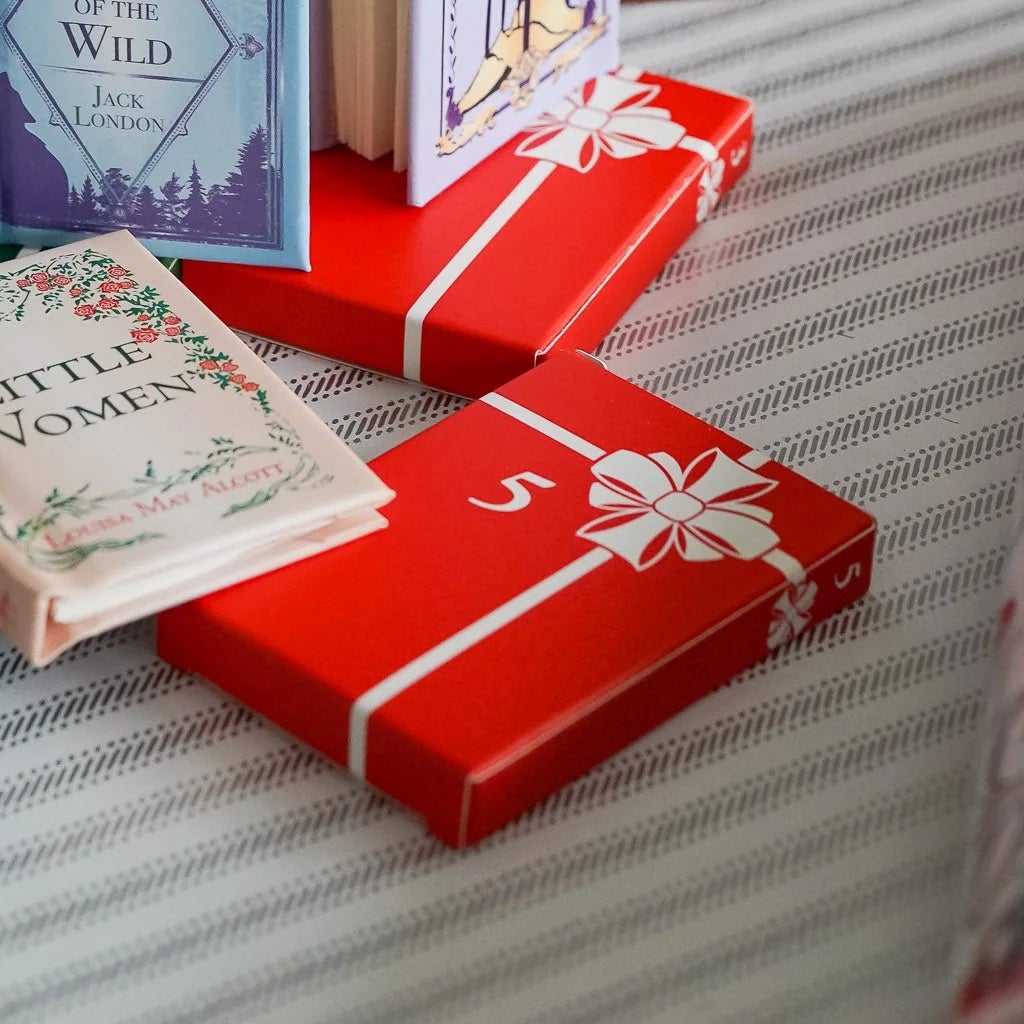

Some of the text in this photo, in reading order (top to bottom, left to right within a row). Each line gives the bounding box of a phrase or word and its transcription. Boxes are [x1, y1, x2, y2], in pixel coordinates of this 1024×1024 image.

[111, 0, 160, 22] THE
[57, 19, 174, 67] WILD
[91, 84, 145, 110] JACK
[73, 105, 166, 134] LONDON
[467, 470, 557, 513] 5
[833, 561, 861, 590] 5
